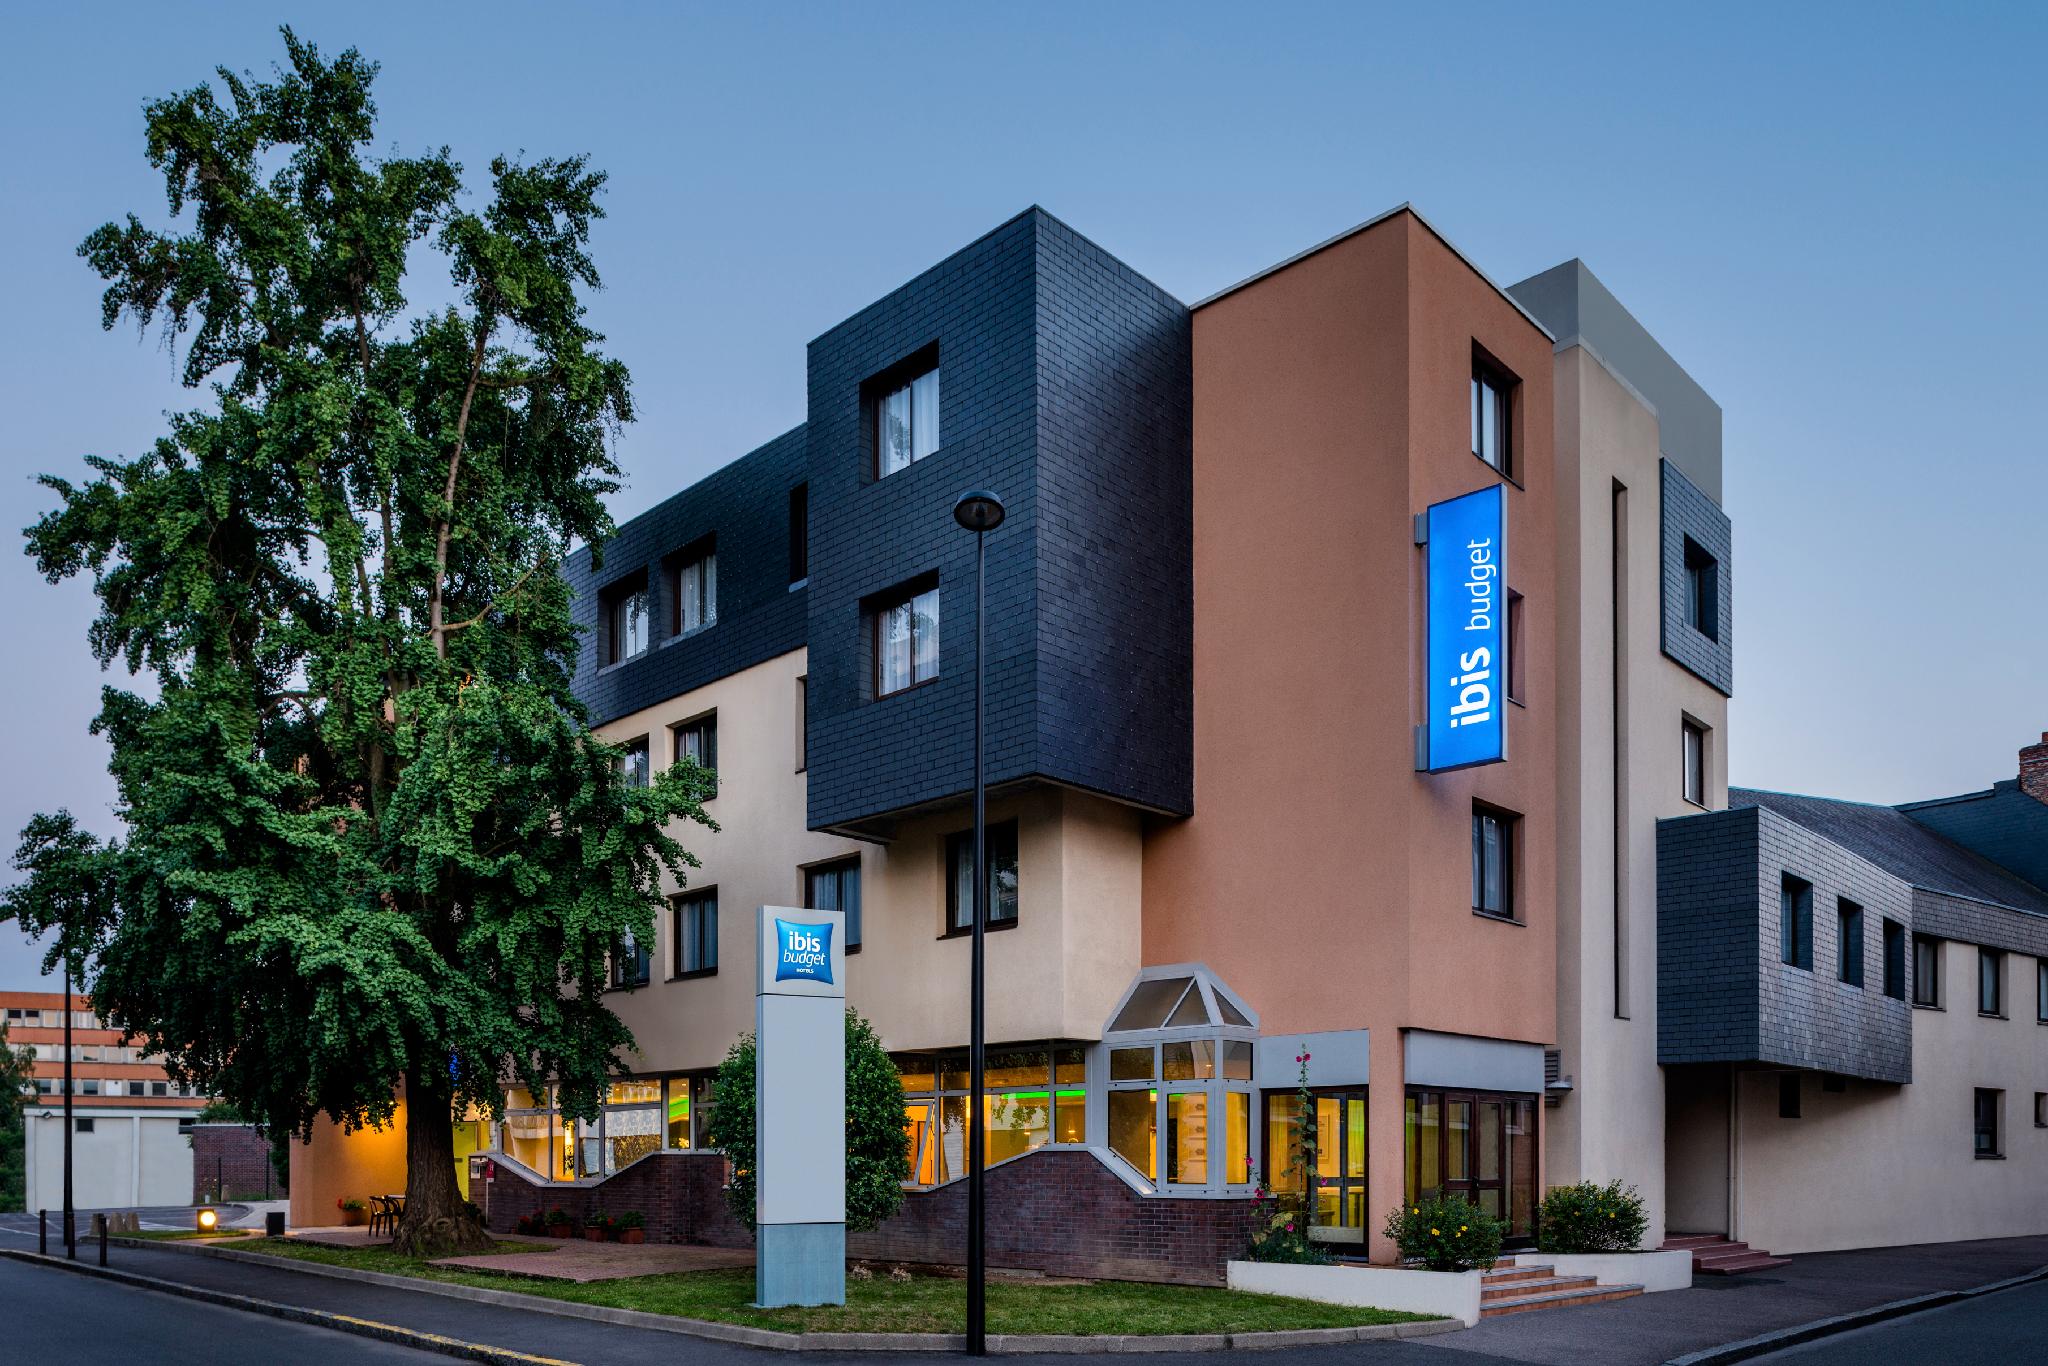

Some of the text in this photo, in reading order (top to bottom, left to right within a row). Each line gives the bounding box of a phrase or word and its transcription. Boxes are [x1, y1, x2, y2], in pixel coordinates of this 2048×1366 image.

[1451, 538, 1496, 728] ibis budget
[789, 931, 821, 952] ibis
[784, 949, 826, 967] budget
